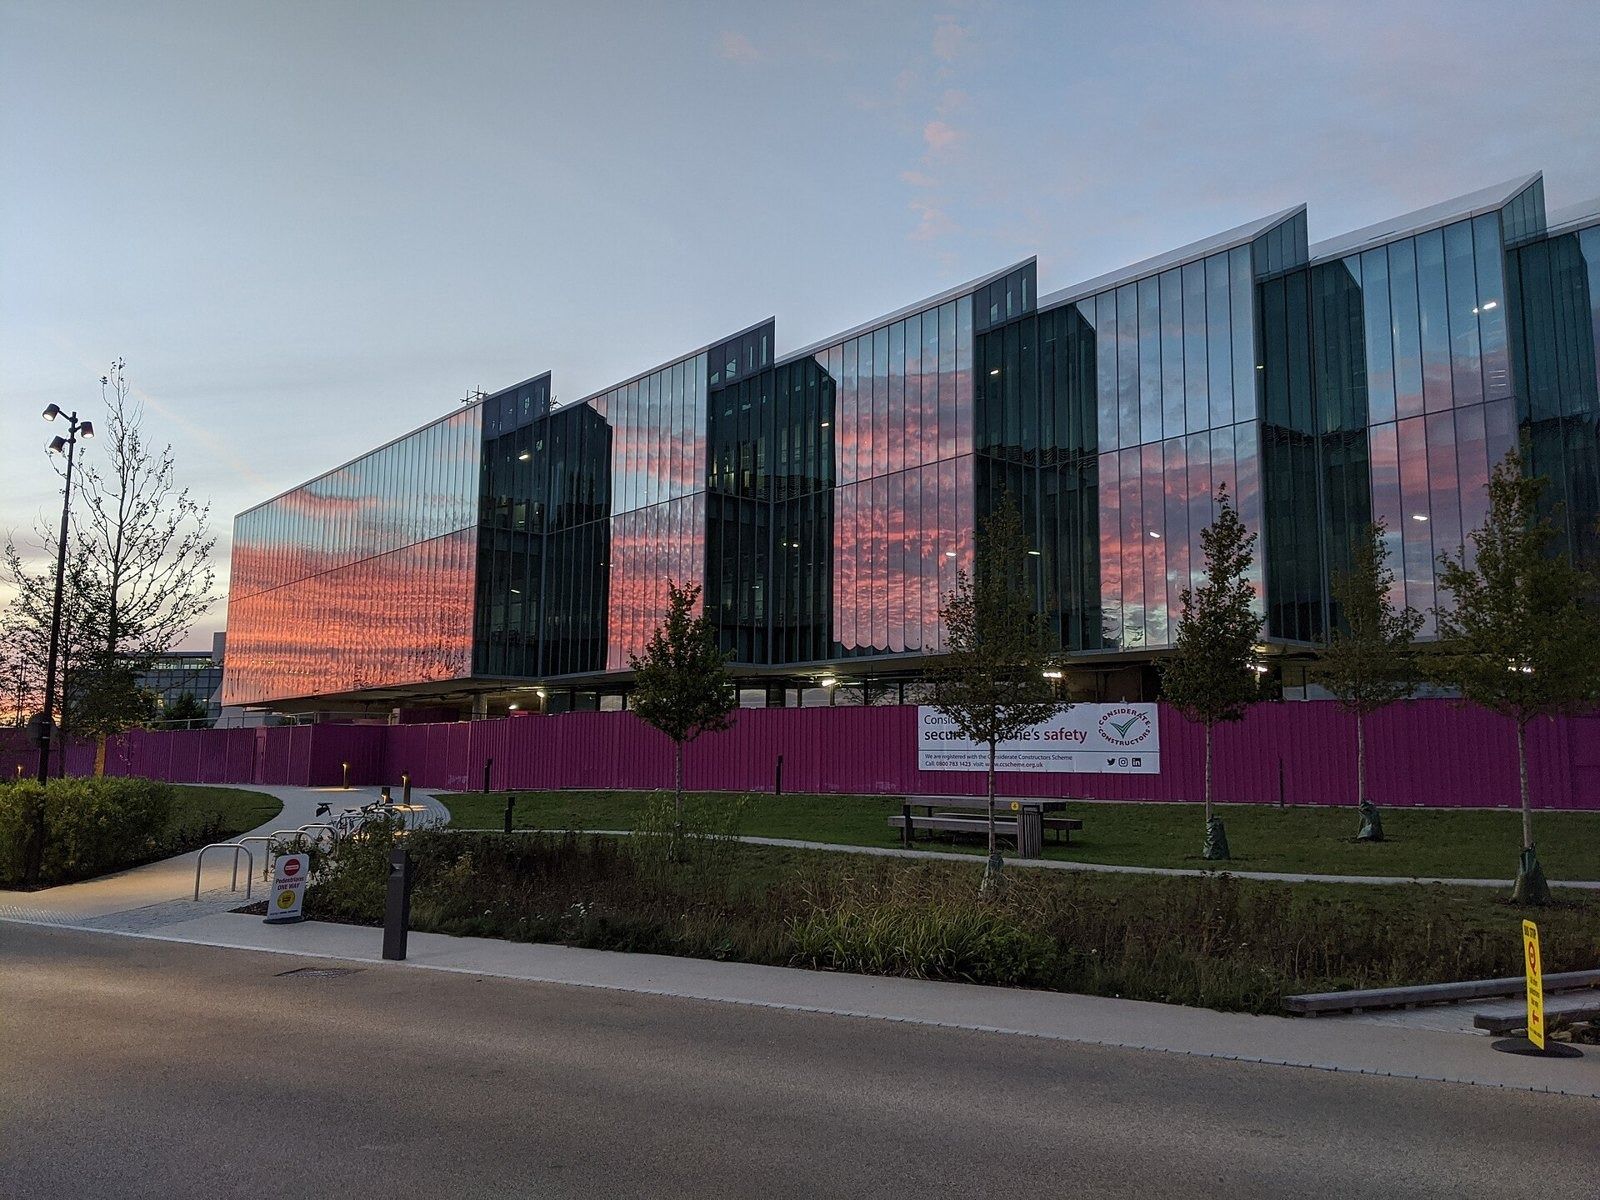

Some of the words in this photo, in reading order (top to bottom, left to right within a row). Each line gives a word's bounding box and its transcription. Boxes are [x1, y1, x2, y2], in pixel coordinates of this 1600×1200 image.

[1098, 708, 1152, 726] CONSIDERATE
[1043, 727, 1088, 744] safety
[1098, 728, 1151, 746] CONSTRUCTORS
[985, 761, 1044, 769] ww.ccscheme.org.uk
